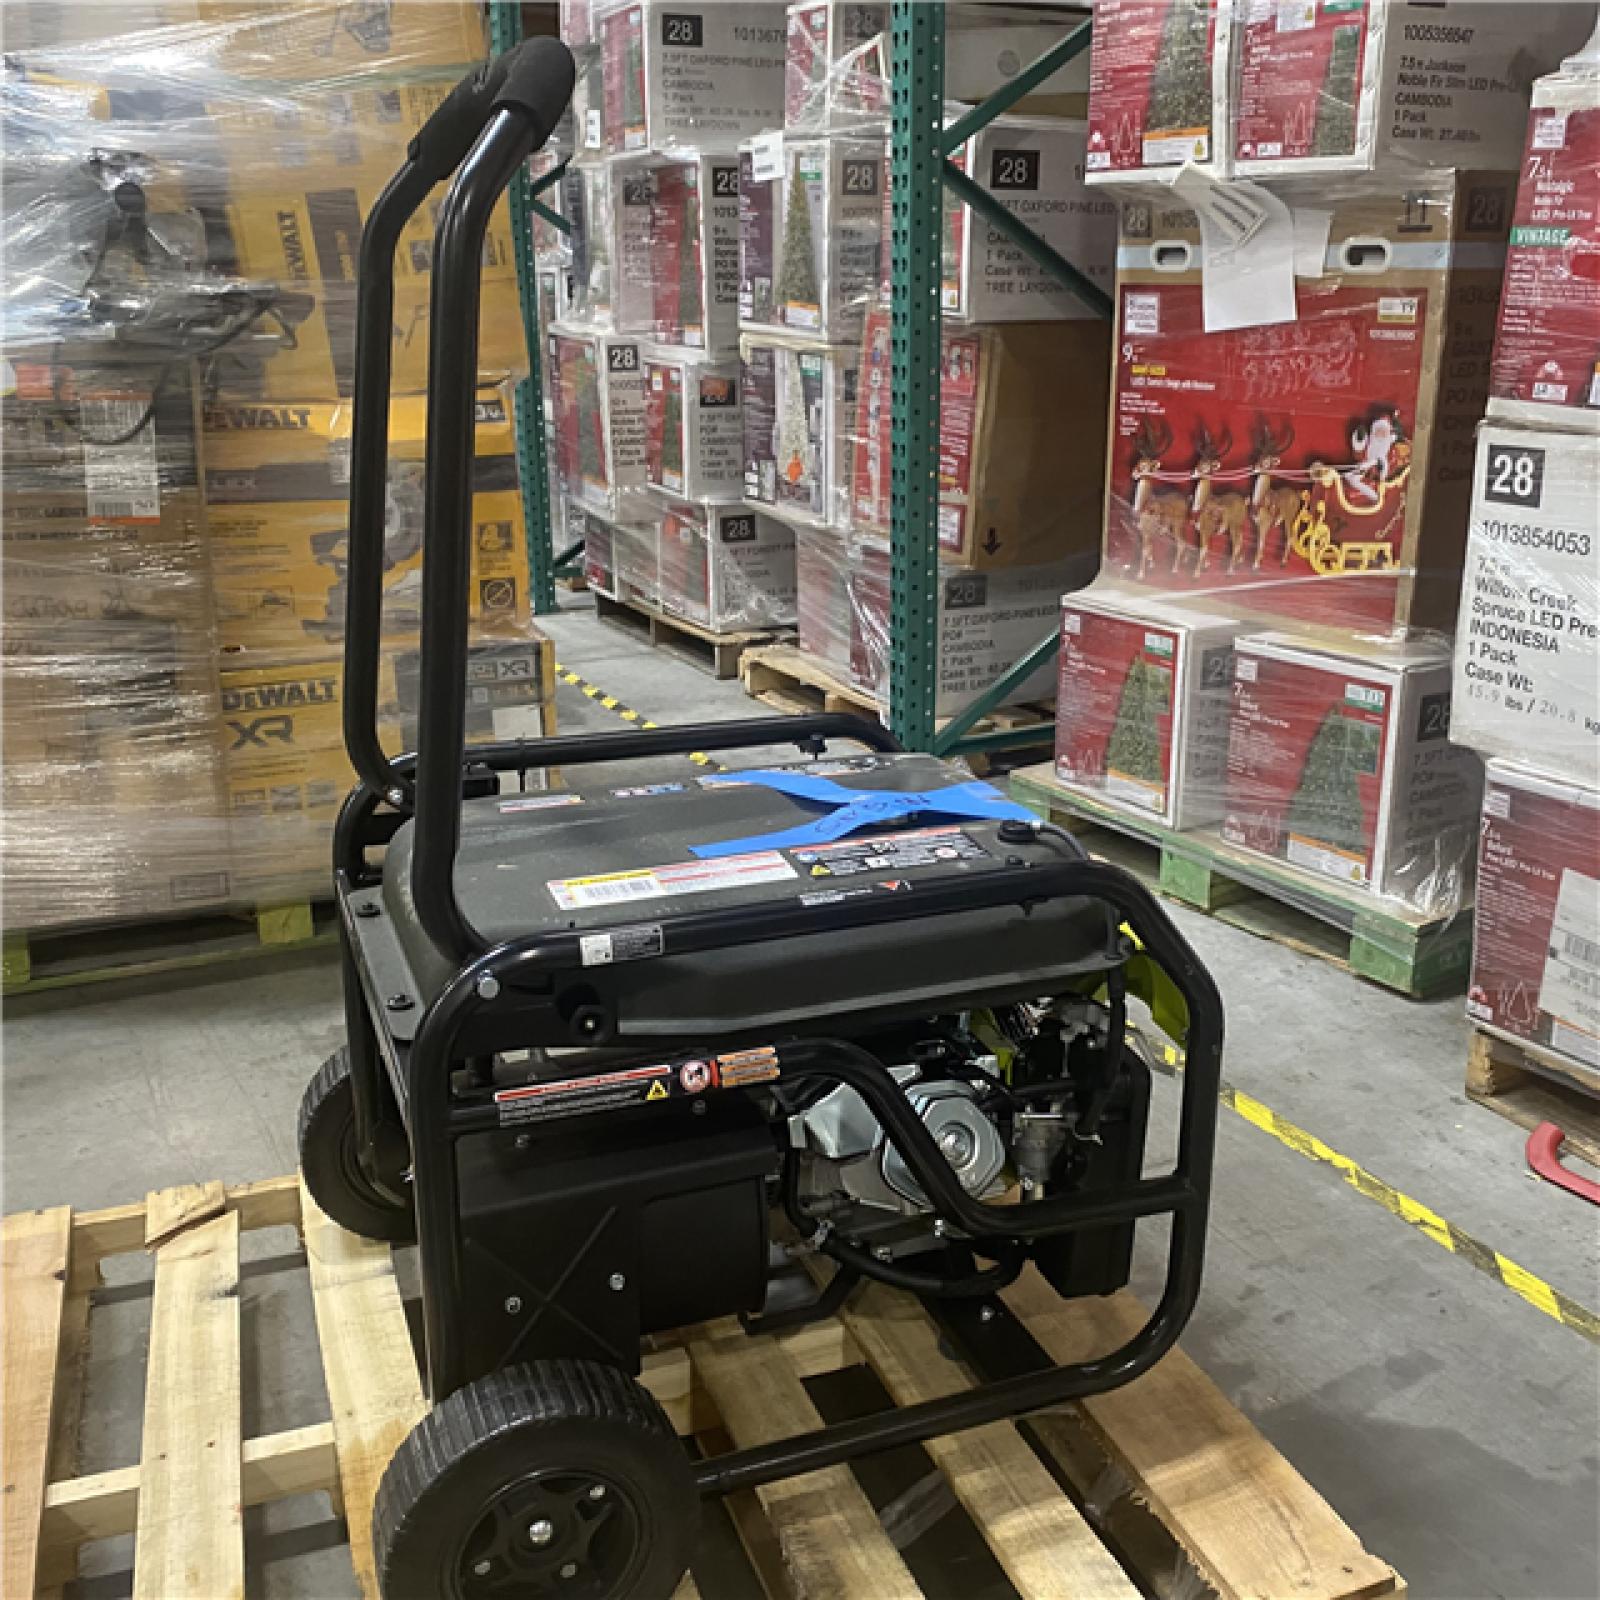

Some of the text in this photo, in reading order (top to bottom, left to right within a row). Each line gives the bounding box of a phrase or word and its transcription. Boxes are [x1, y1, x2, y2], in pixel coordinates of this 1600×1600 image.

[668, 19, 694, 43] 28
[1395, 92, 1453, 107] CAMBODIA
[1402, 110, 1428, 123] Pack
[1392, 126, 1417, 139] Case
[847, 166, 872, 190] 28
[1000, 158, 1029, 183] 28
[1126, 207, 1148, 231] 28
[1472, 193, 1502, 224] 28
[611, 348, 635, 367] 28
[1492, 453, 1534, 497] 28
[727, 520, 750, 539] 28
[1482, 519, 1592, 556] 1013854053
[951, 581, 977, 605] 28
[1473, 596, 1526, 623] Spruce
[1530, 610, 1564, 631] LED
[1470, 618, 1561, 653] INDONESIA
[1469, 640, 1518, 666] 1 Pack
[500, 659, 530, 677] XR
[1465, 660, 1503, 685] Case
[227, 714, 295, 749] XR
